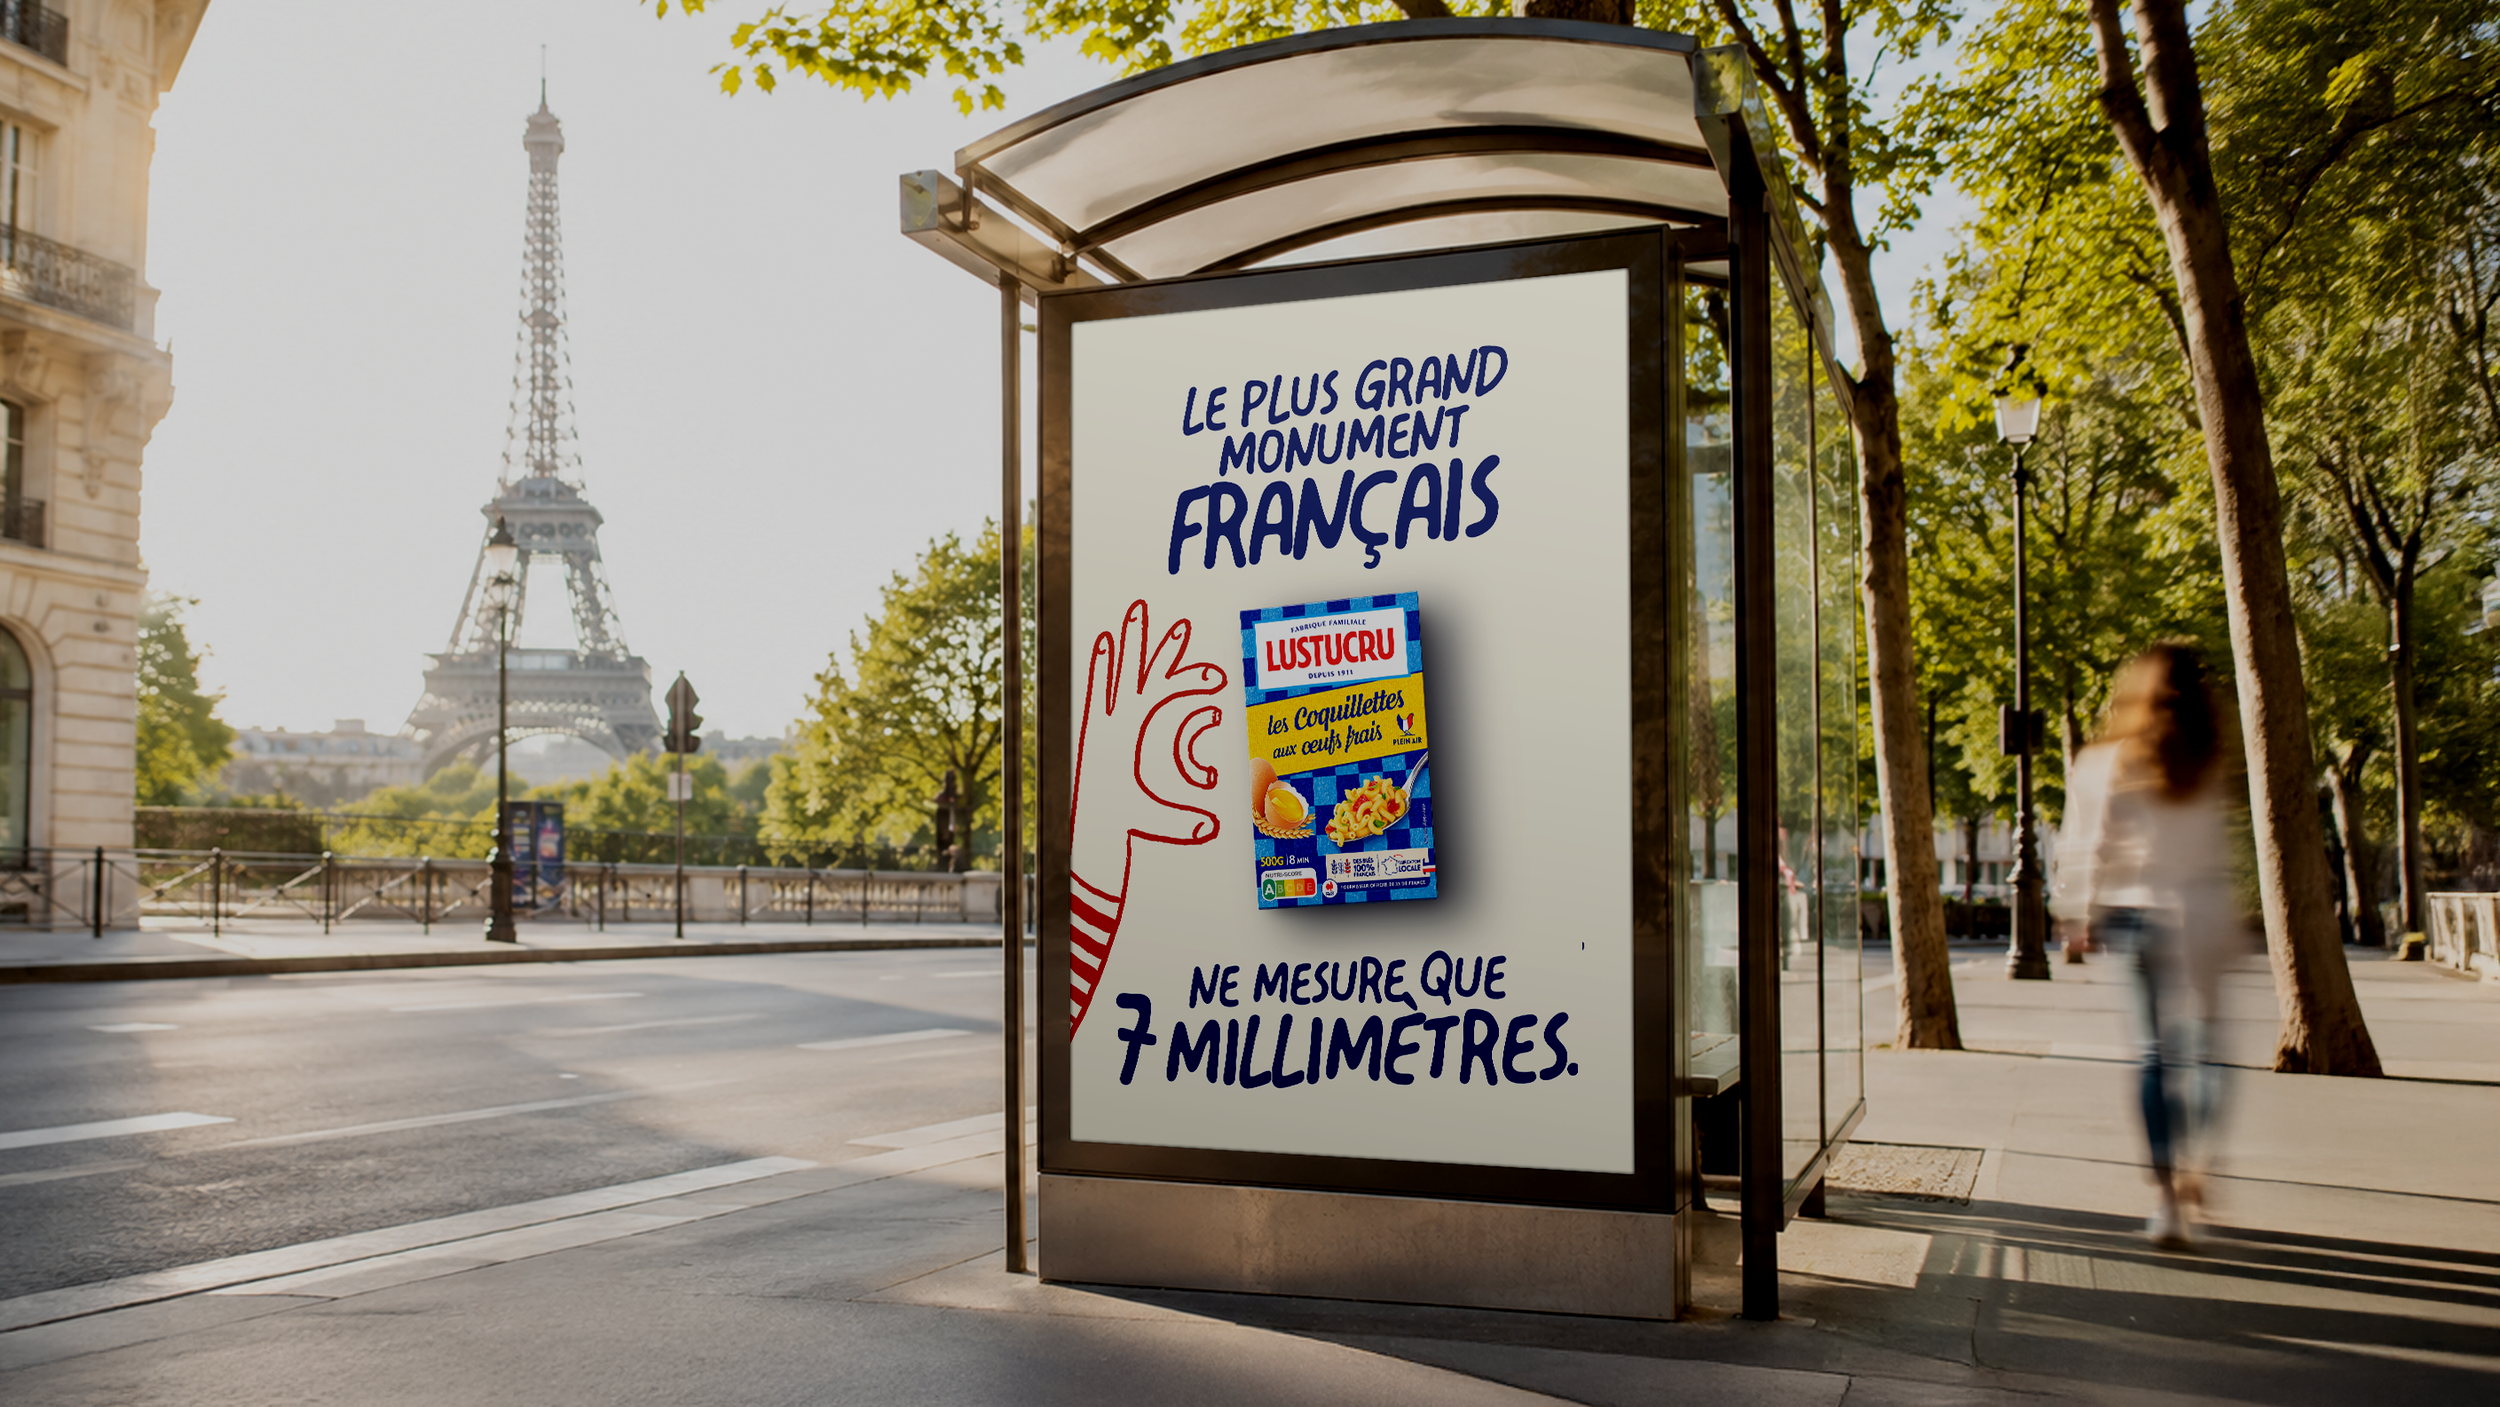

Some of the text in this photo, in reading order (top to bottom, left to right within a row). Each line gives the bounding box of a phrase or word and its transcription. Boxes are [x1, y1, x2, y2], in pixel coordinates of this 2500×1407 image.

[1181, 344, 1509, 436] LE PLUS GRAND
[1219, 404, 1469, 476] MONUMENT
[1167, 455, 1501, 575] FRANÇAIS
[1291, 621, 1326, 633] FABRIQUE
[1266, 628, 1394, 671] LUSTUCRU
[1309, 671, 1334, 679] DEPUIS
[1268, 690, 1404, 735] les Coquillettes
[1273, 744, 1297, 759] aux
[1345, 721, 1382, 753] frais
[1261, 856, 1283, 867] 500G
[1289, 855, 1295, 864] 8
[1353, 864, 1375, 872] 100%
[1399, 864, 1421, 872] LOCALE
[1265, 884, 1274, 895] A
[1278, 885, 1283, 893] B
[1286, 884, 1293, 892] C
[1307, 883, 1313, 891] E
[1189, 951, 1507, 1008] NE MESURE QUE
[1116, 991, 1579, 1089] 7 MILLIMÈTRES.
